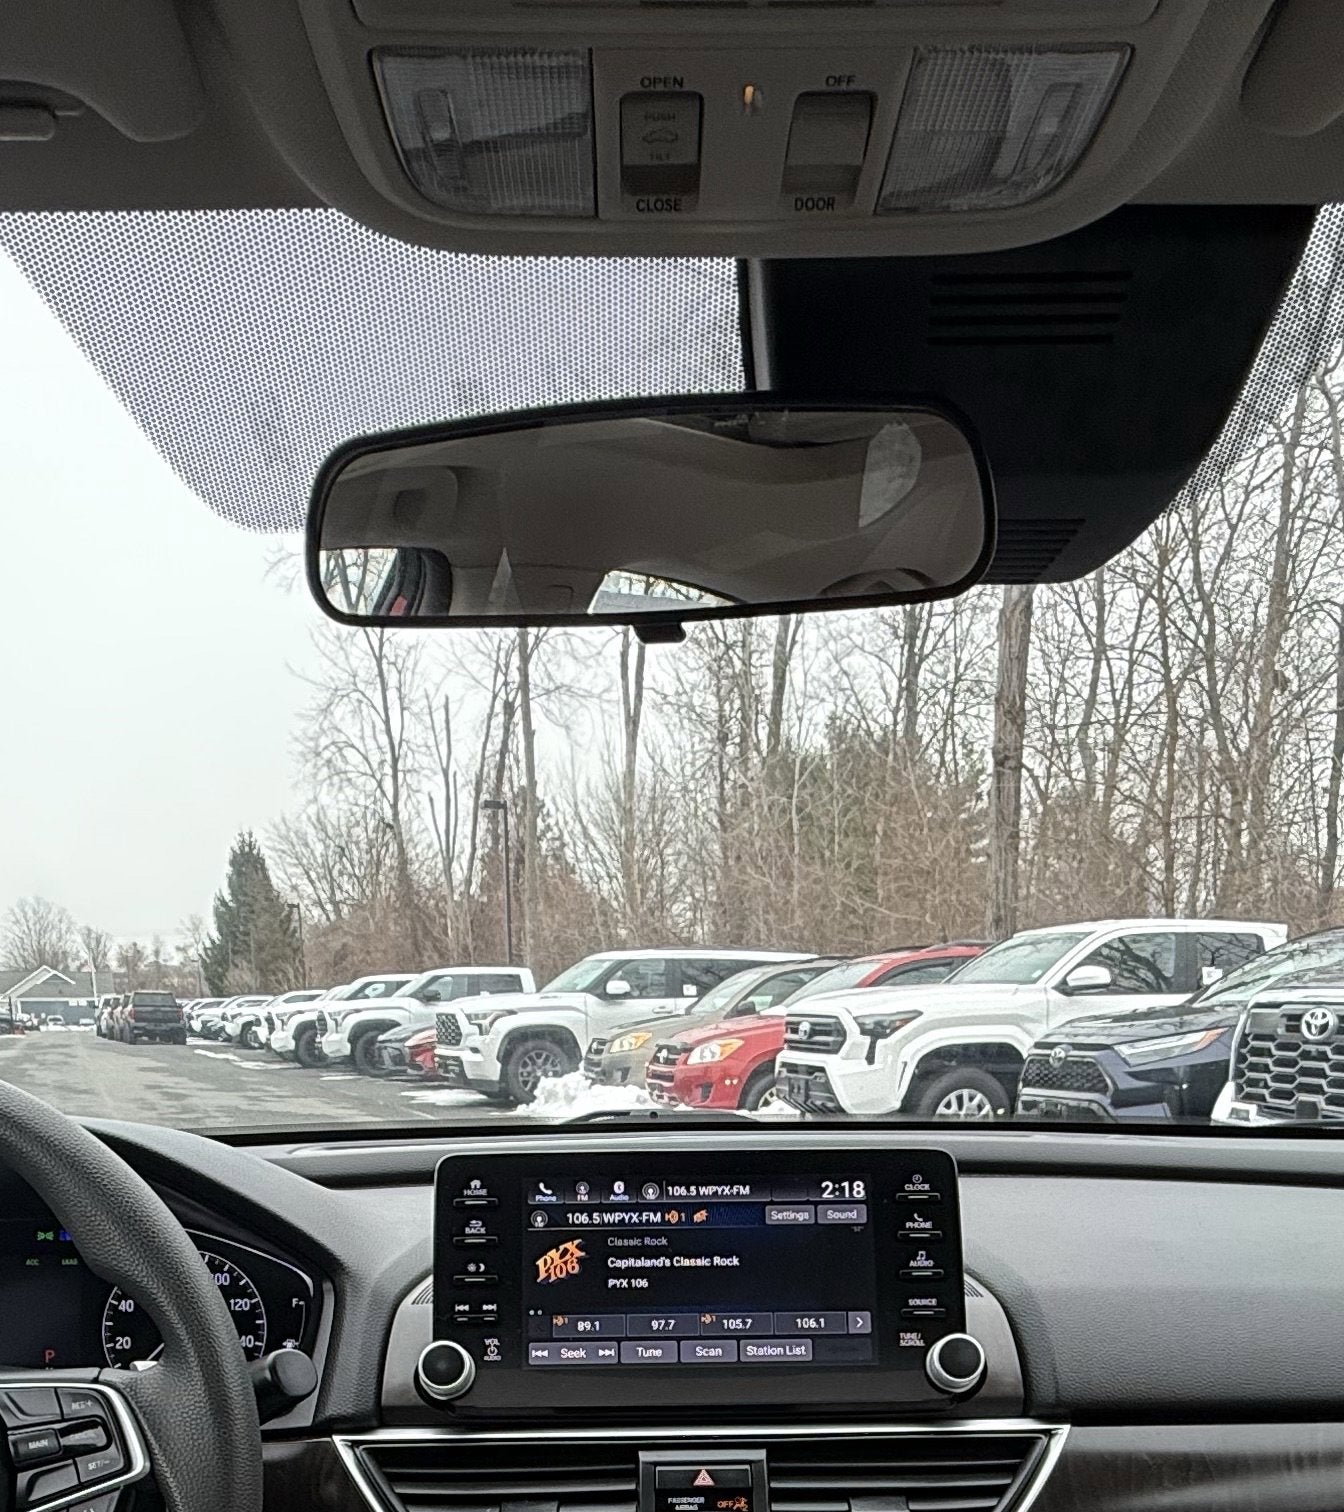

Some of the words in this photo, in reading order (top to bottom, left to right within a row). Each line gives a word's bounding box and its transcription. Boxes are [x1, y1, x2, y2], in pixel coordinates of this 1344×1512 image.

[639, 76, 684, 89] OPEN
[825, 74, 856, 88] OFF
[635, 198, 682, 213] CLOSE
[794, 197, 835, 212] DOOR
[667, 1186, 697, 1197] 106.5
[821, 1180, 866, 1199] 2:18
[577, 1194, 589, 1202] FM
[566, 1212, 600, 1225] 106.5
[770, 1210, 810, 1222] Settings
[826, 1209, 858, 1220] Sound
[465, 1227, 486, 1235] BACK
[607, 1236, 642, 1246] Classic
[644, 1236, 668, 1246] Rock
[26, 1258, 40, 1266] ACC
[607, 1257, 671, 1270] Capitaland's
[673, 1257, 712, 1267] Classic
[713, 1256, 740, 1266] Rock
[549, 1258, 580, 1283] 106
[210, 1273, 231, 1286] 00
[607, 1278, 629, 1288] PYX
[631, 1278, 649, 1288] 106
[118, 1299, 135, 1312] 40
[229, 1298, 251, 1311] 120
[577, 1321, 600, 1332] 89.1
[651, 1319, 676, 1331] 97.7
[722, 1318, 753, 1330] 105.7
[795, 1317, 825, 1329] 106.1
[115, 1336, 132, 1350] 20
[45, 1350, 55, 1363] P
[560, 1347, 587, 1359] Seek
[636, 1347, 663, 1358] Tune
[695, 1346, 723, 1357] Scan
[746, 1345, 784, 1356] Station
[786, 1345, 807, 1356] List
[28, 1439, 49, 1450] MAIN
[716, 1500, 734, 1509] OFF
